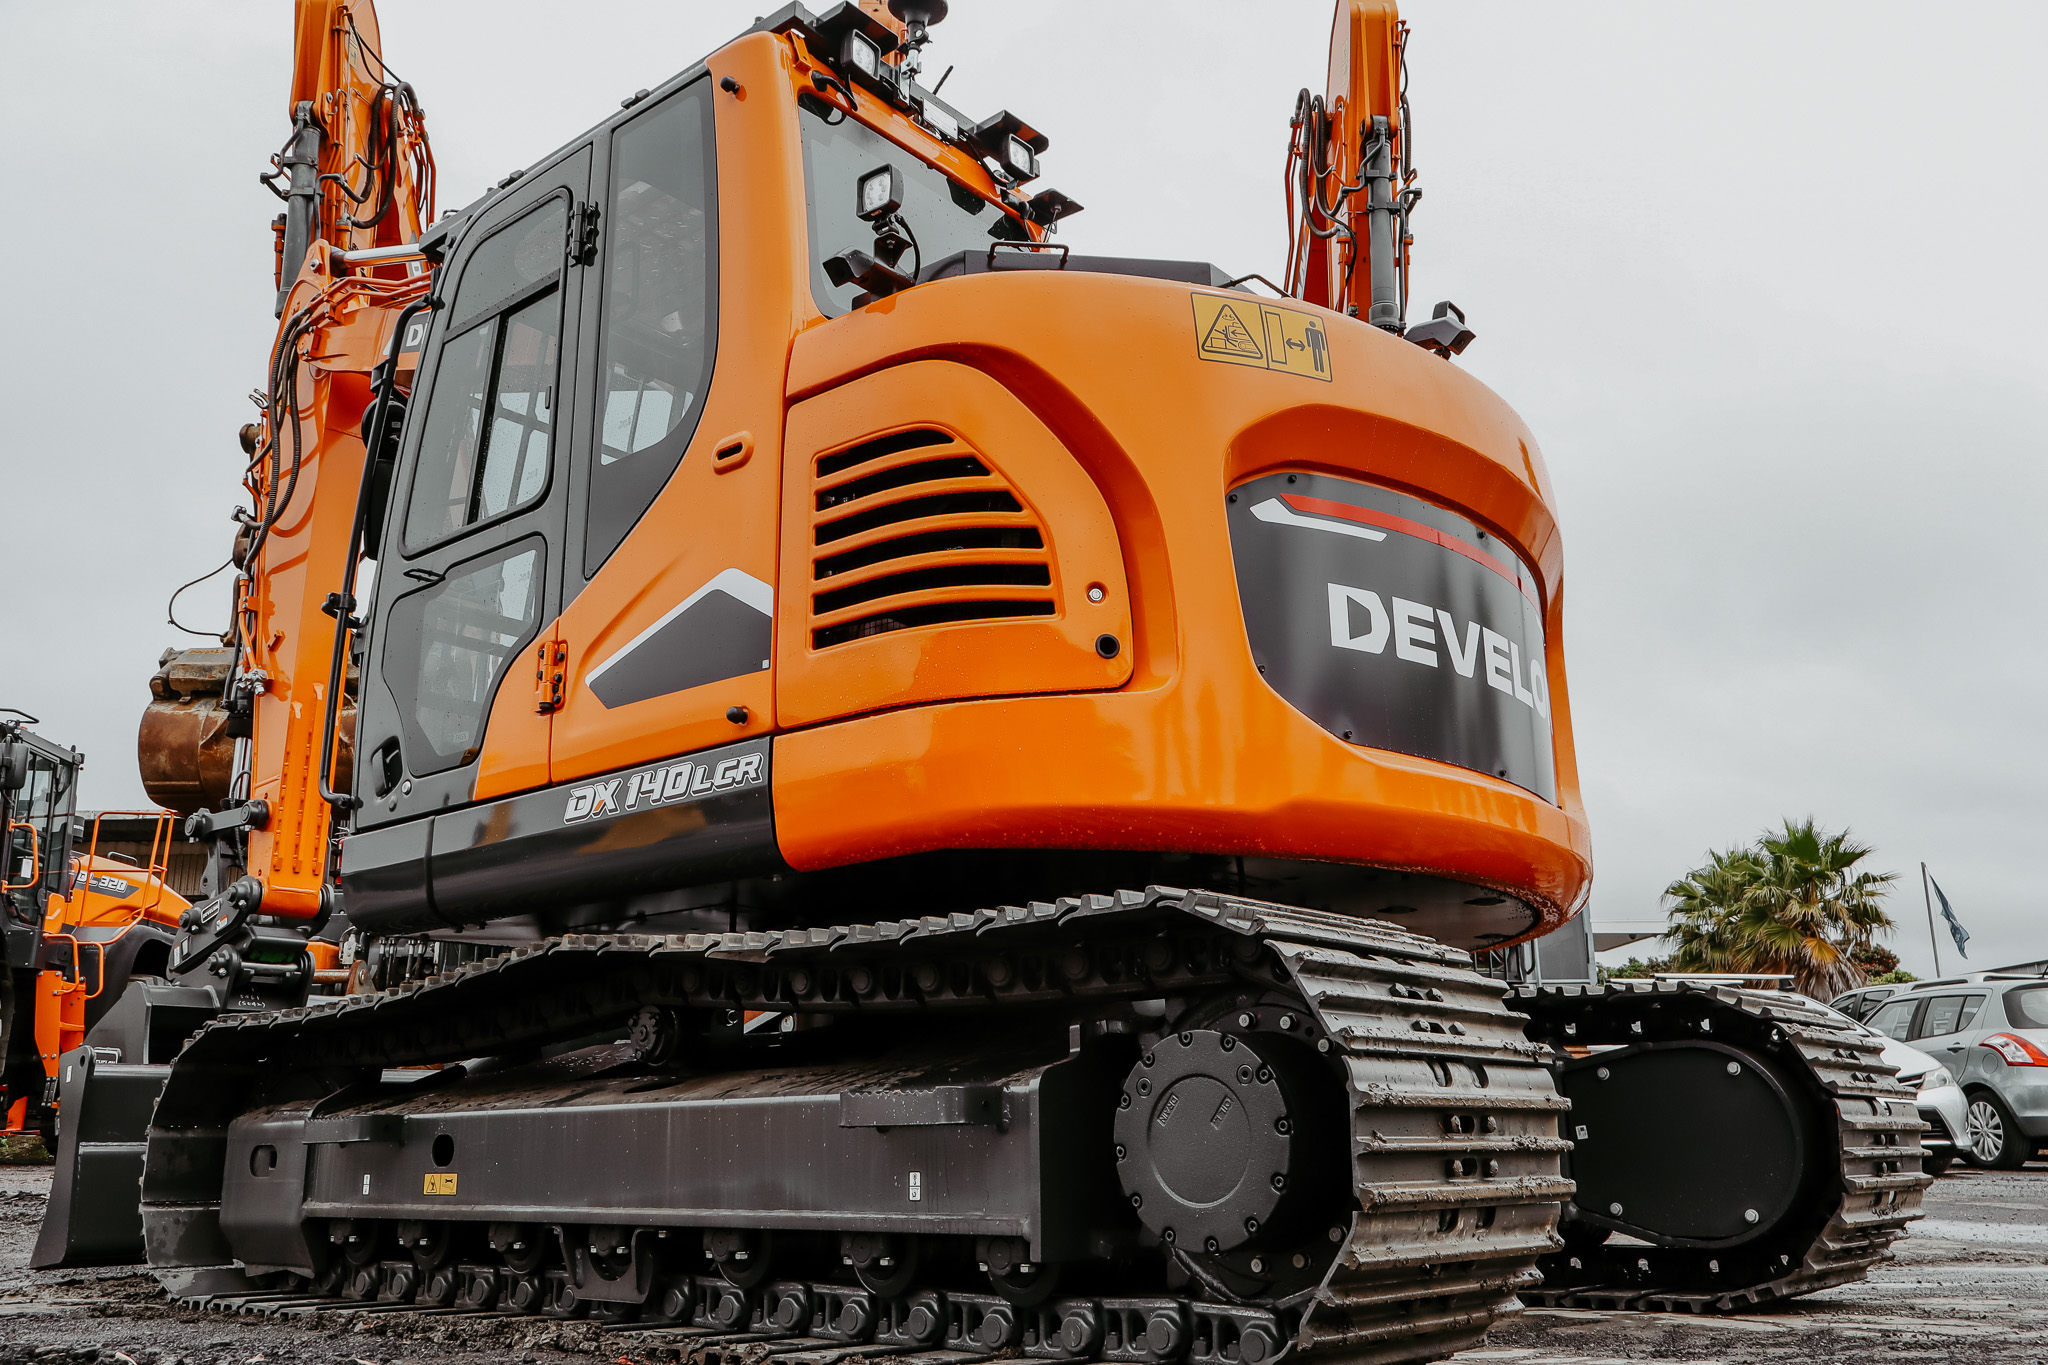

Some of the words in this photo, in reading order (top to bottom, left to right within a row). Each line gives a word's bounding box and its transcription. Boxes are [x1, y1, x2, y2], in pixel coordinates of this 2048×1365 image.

[1327, 583, 1551, 728] DEVELO
[564, 778, 623, 824] DX
[1160, 1094, 1179, 1125] DRAIN
